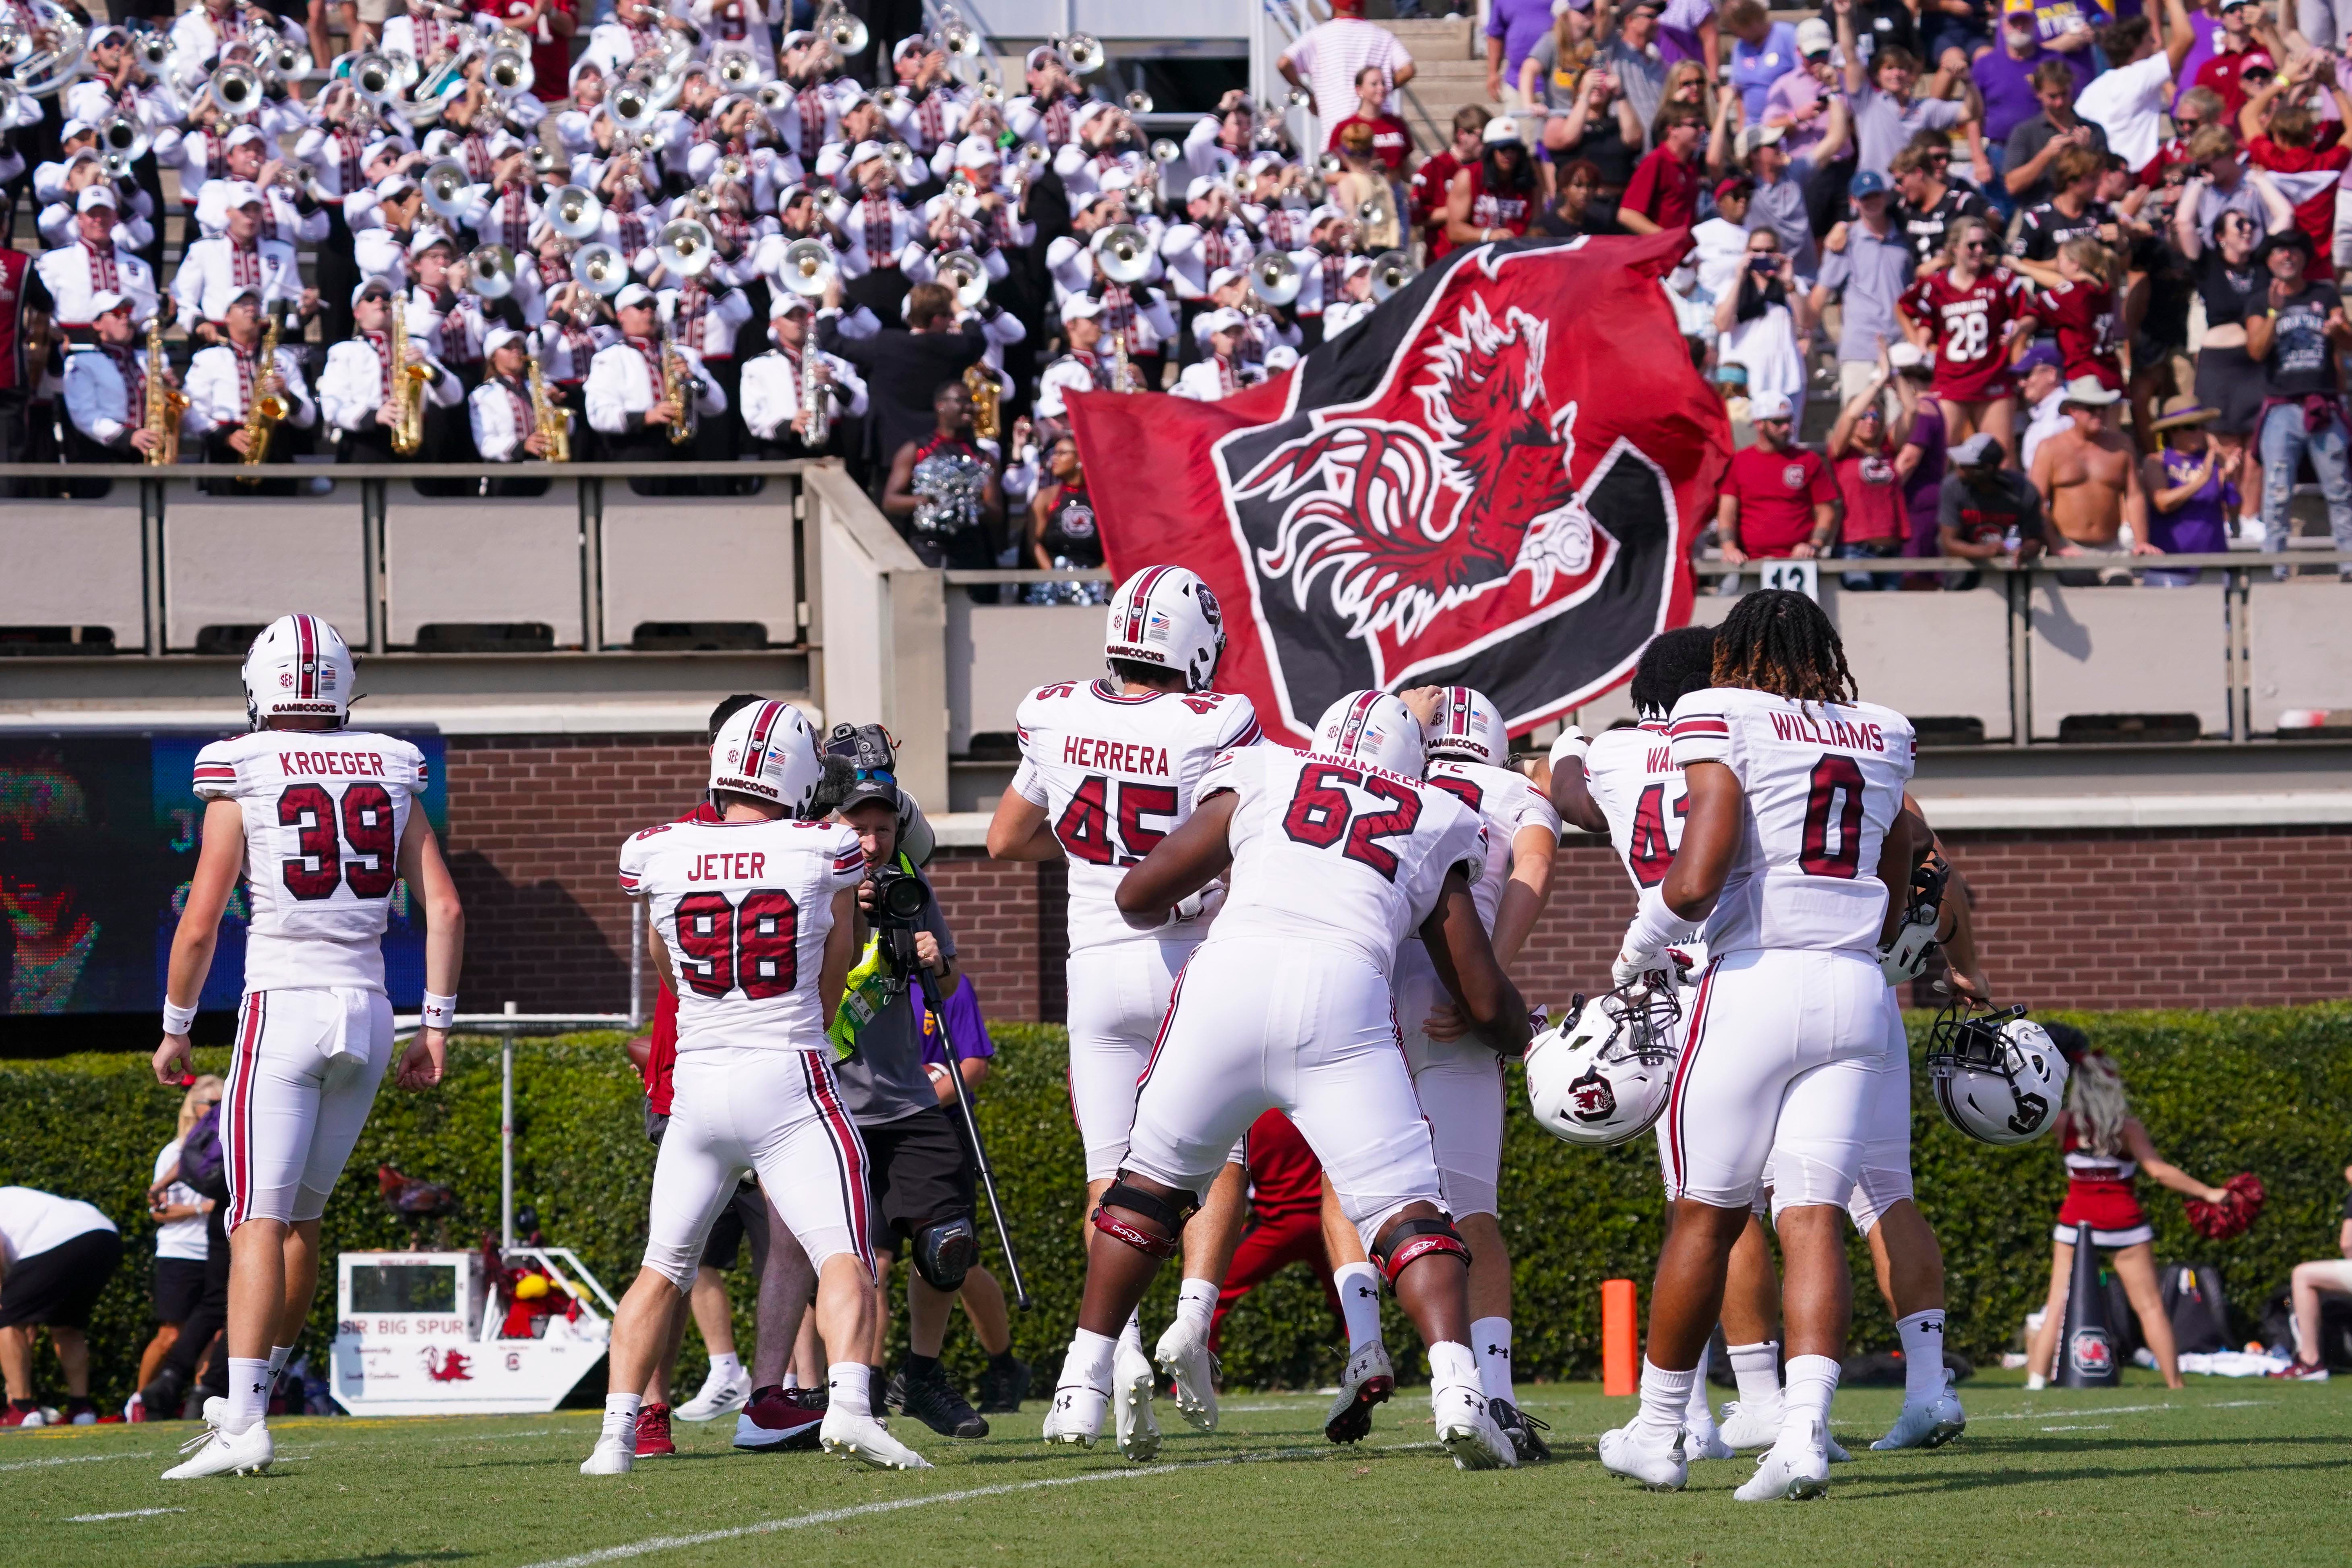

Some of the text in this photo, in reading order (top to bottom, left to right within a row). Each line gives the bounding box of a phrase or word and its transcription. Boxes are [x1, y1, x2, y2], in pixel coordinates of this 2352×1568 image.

[1945, 312, 1989, 362] 28
[1114, 615, 1122, 629] SEC
[1107, 645, 1165, 662] GAMECOCKS
[280, 674, 293, 687] SEC
[272, 704, 337, 713] GAMECOCKS
[1328, 725, 1339, 738] SEC
[1769, 712, 1884, 752] WILLIAMS
[279, 751, 386, 776] KROEGER
[728, 749, 739, 763] SEC
[1063, 735, 1169, 777] HERRERA
[1293, 749, 1427, 790] WANNAMAKER
[717, 777, 779, 798] GAMECOCKS
[1054, 775, 1179, 869] 45
[1282, 763, 1423, 884] 62
[1798, 753, 1866, 879] 0
[277, 783, 396, 901] 39
[687, 852, 766, 881] JETER
[674, 888, 799, 1000] 98
[846, 1009, 860, 1023] PHOTO
[1112, 1225, 1148, 1245] DONJOY
[1401, 1240, 1438, 1260] DONJOY
[340, 1320, 463, 1335] SIR BIG SPUR
